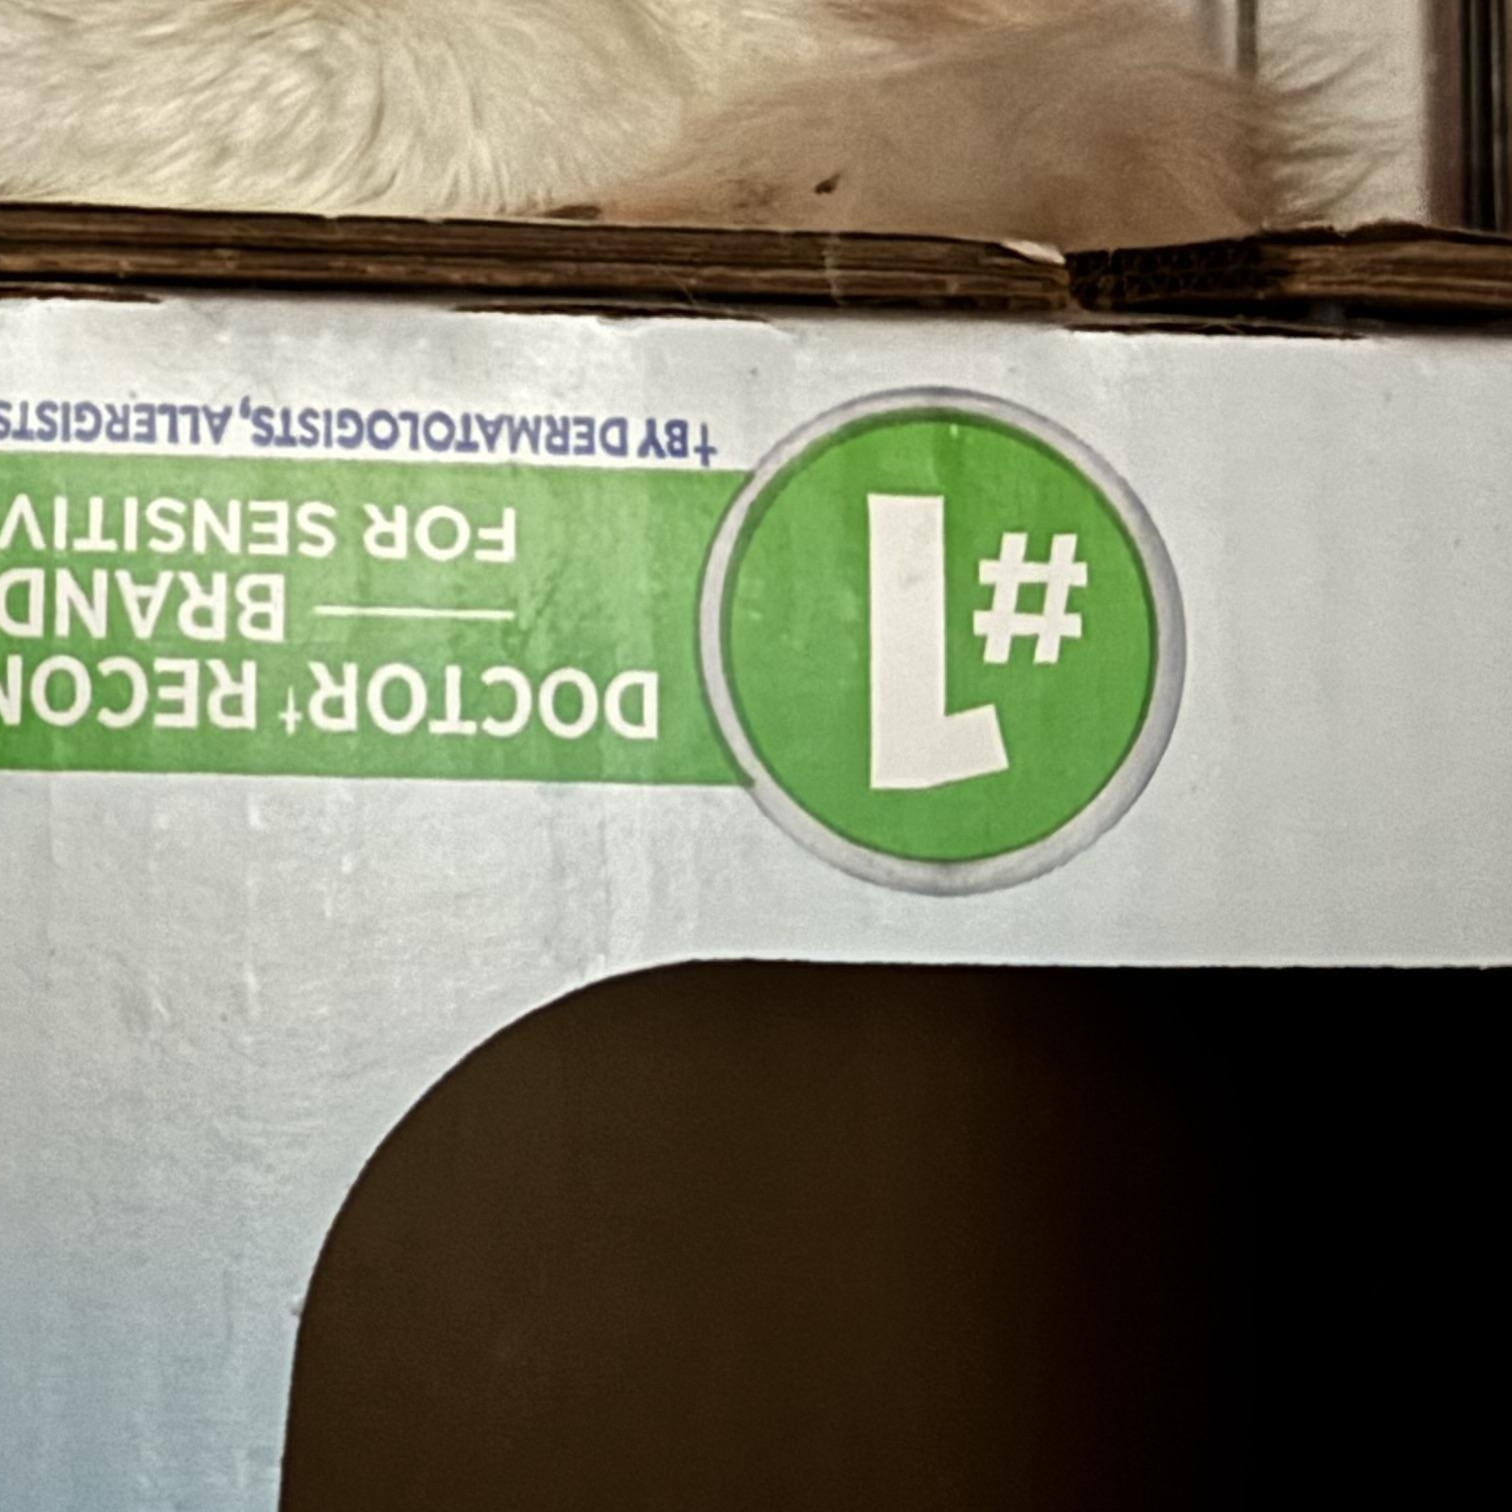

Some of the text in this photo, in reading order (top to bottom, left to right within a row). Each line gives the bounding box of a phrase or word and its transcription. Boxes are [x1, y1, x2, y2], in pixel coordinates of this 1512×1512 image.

[238, 394, 629, 457] DERMATOLOGISTS,
[361, 502, 517, 563] FOR
[867, 492, 1088, 790] #1
